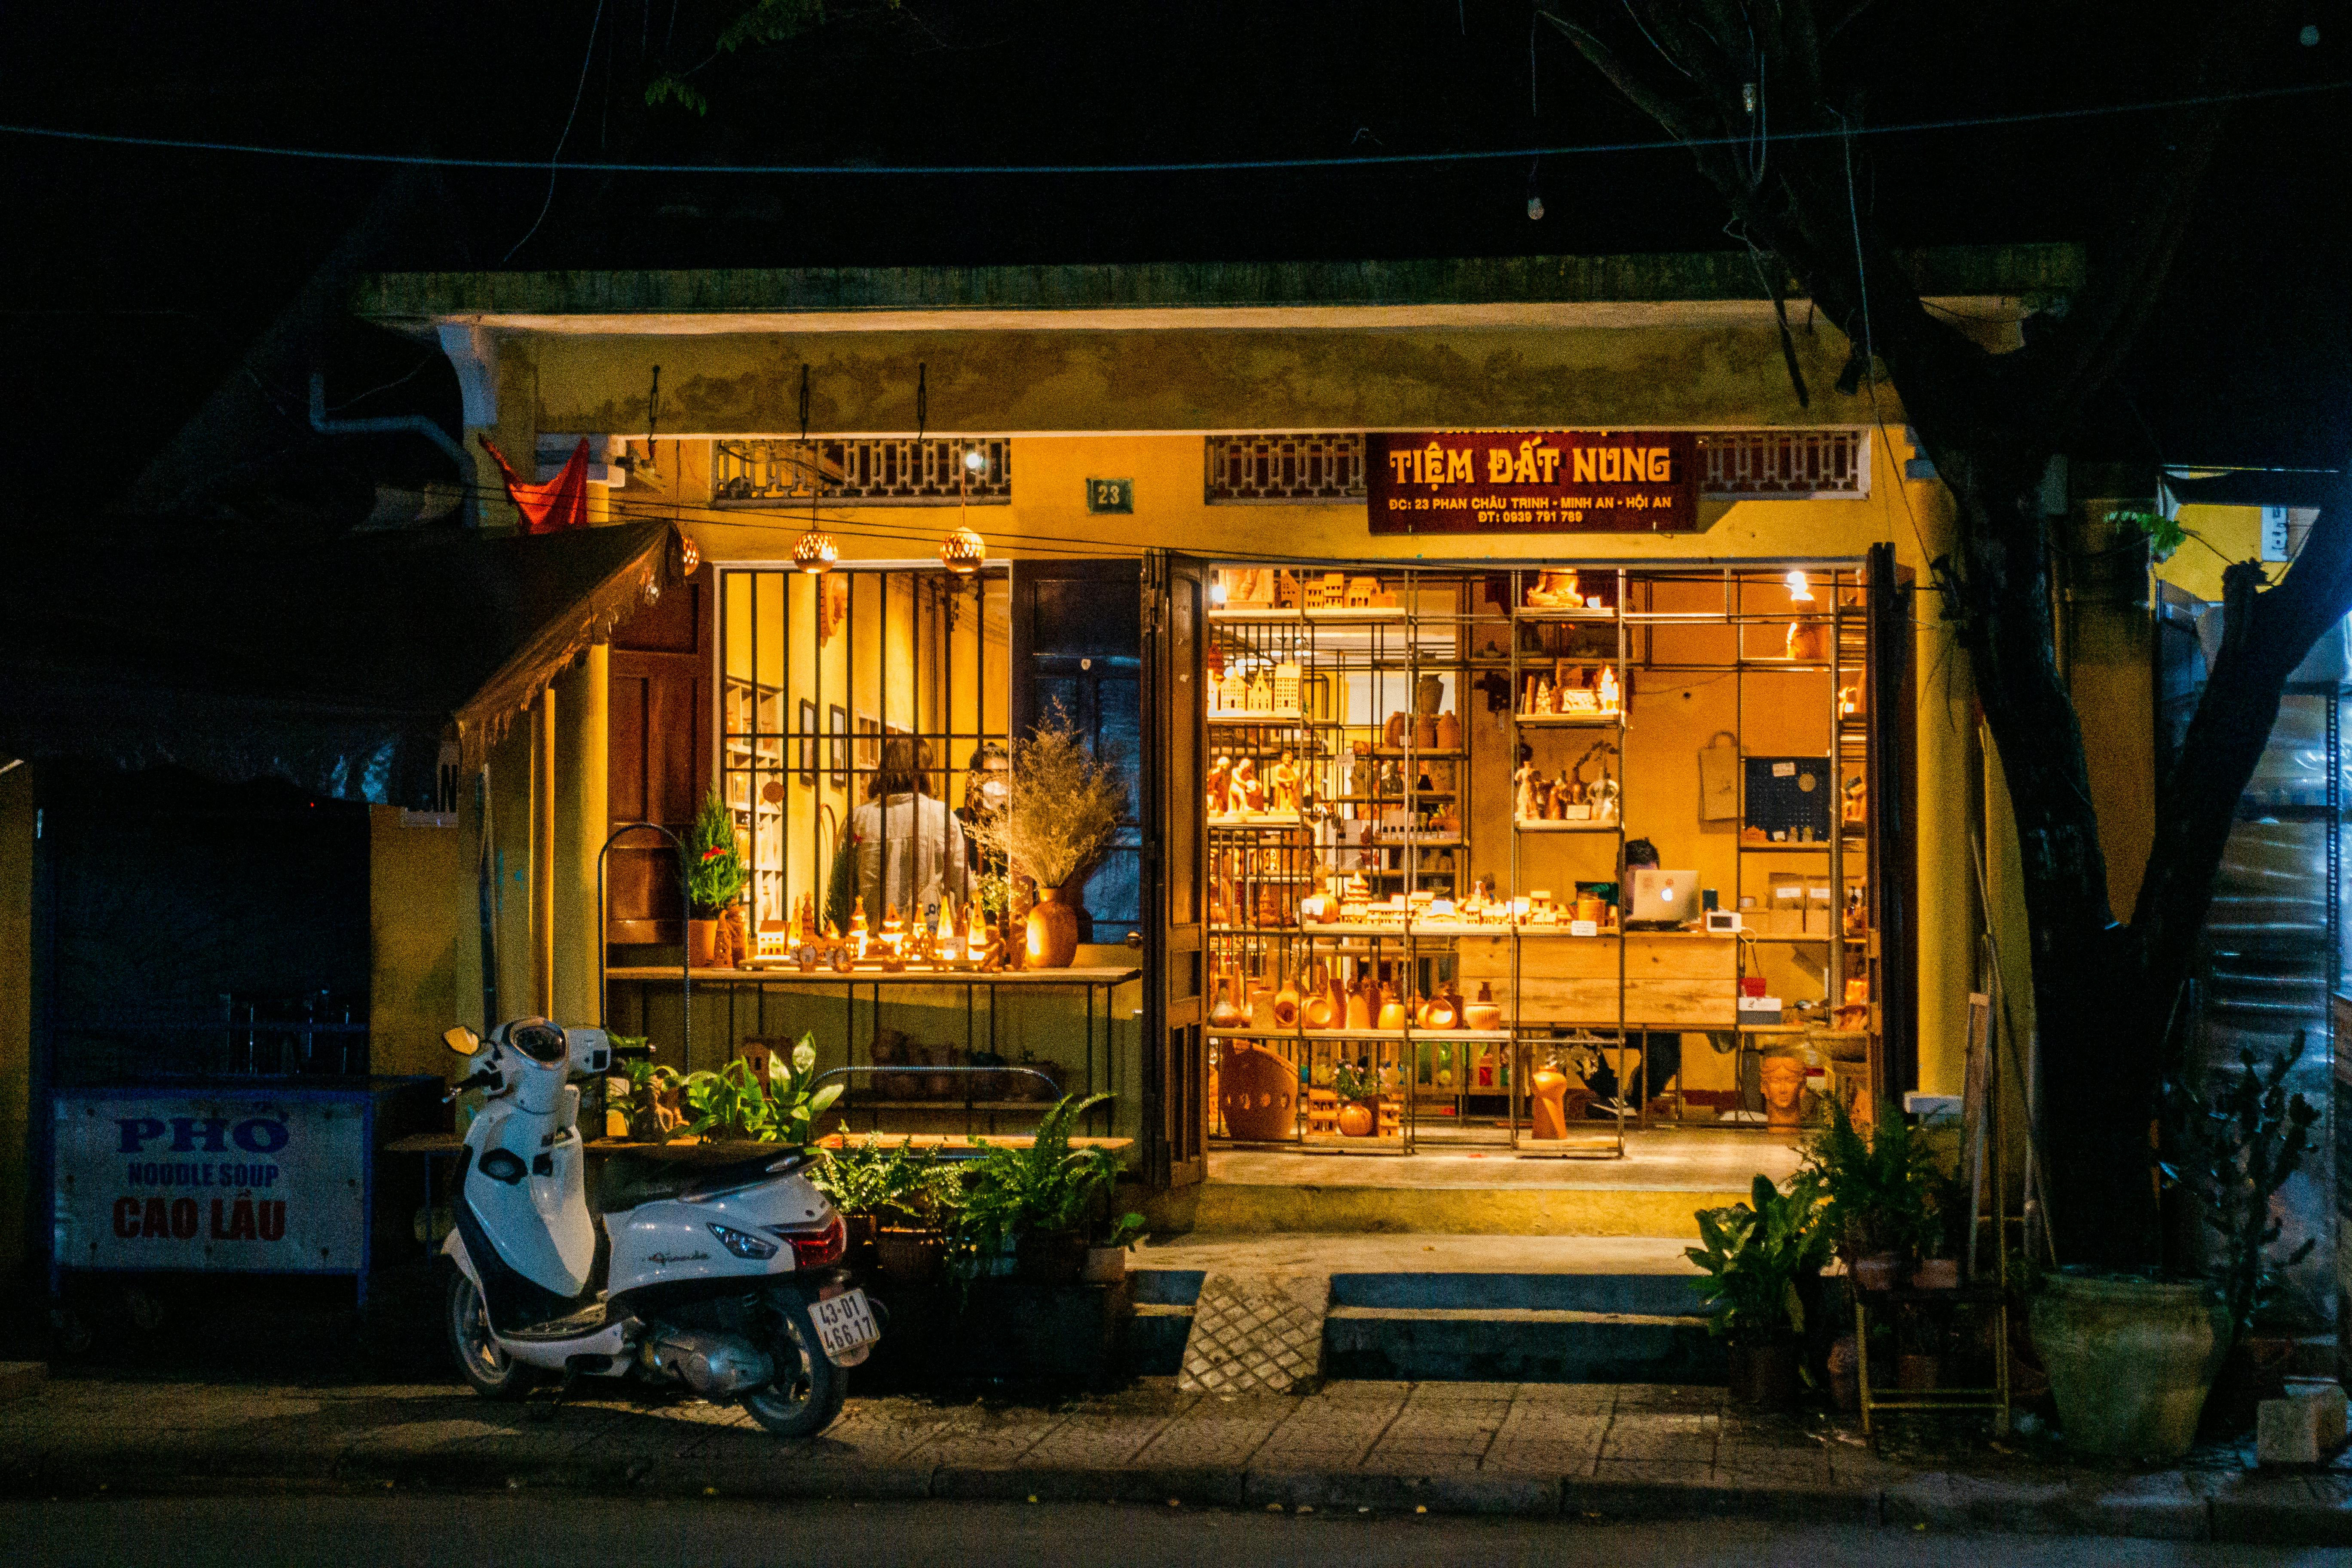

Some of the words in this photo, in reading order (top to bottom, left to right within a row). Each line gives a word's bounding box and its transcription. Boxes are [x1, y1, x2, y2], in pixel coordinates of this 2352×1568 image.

[1389, 441, 1475, 491] TIỆM
[1487, 436, 1559, 483] ĐẤT
[1573, 447, 1671, 482] NUNG
[1098, 484, 1120, 505] 23
[1389, 499, 1412, 510] ĐC:
[1415, 498, 1429, 510] 23
[1433, 498, 1467, 510] PHAN
[1471, 495, 1507, 510] CHÂU
[1510, 497, 1549, 510] TRINH
[1561, 497, 1592, 509] MINH
[1595, 497, 1614, 509] AN
[1626, 494, 1648, 511] HỘI
[1652, 497, 1672, 508] AN
[1478, 511, 1500, 523] ĐT:
[1503, 511, 1533, 523] 0939
[1536, 511, 1556, 523] 791
[1561, 511, 1583, 523] 789
[115, 1102, 290, 1153] PHỞ
[128, 1163, 214, 1186] NOODLE
[218, 1164, 279, 1187] SOUP
[113, 1196, 198, 1239] CAO
[824, 1317, 873, 1351] 466.17
